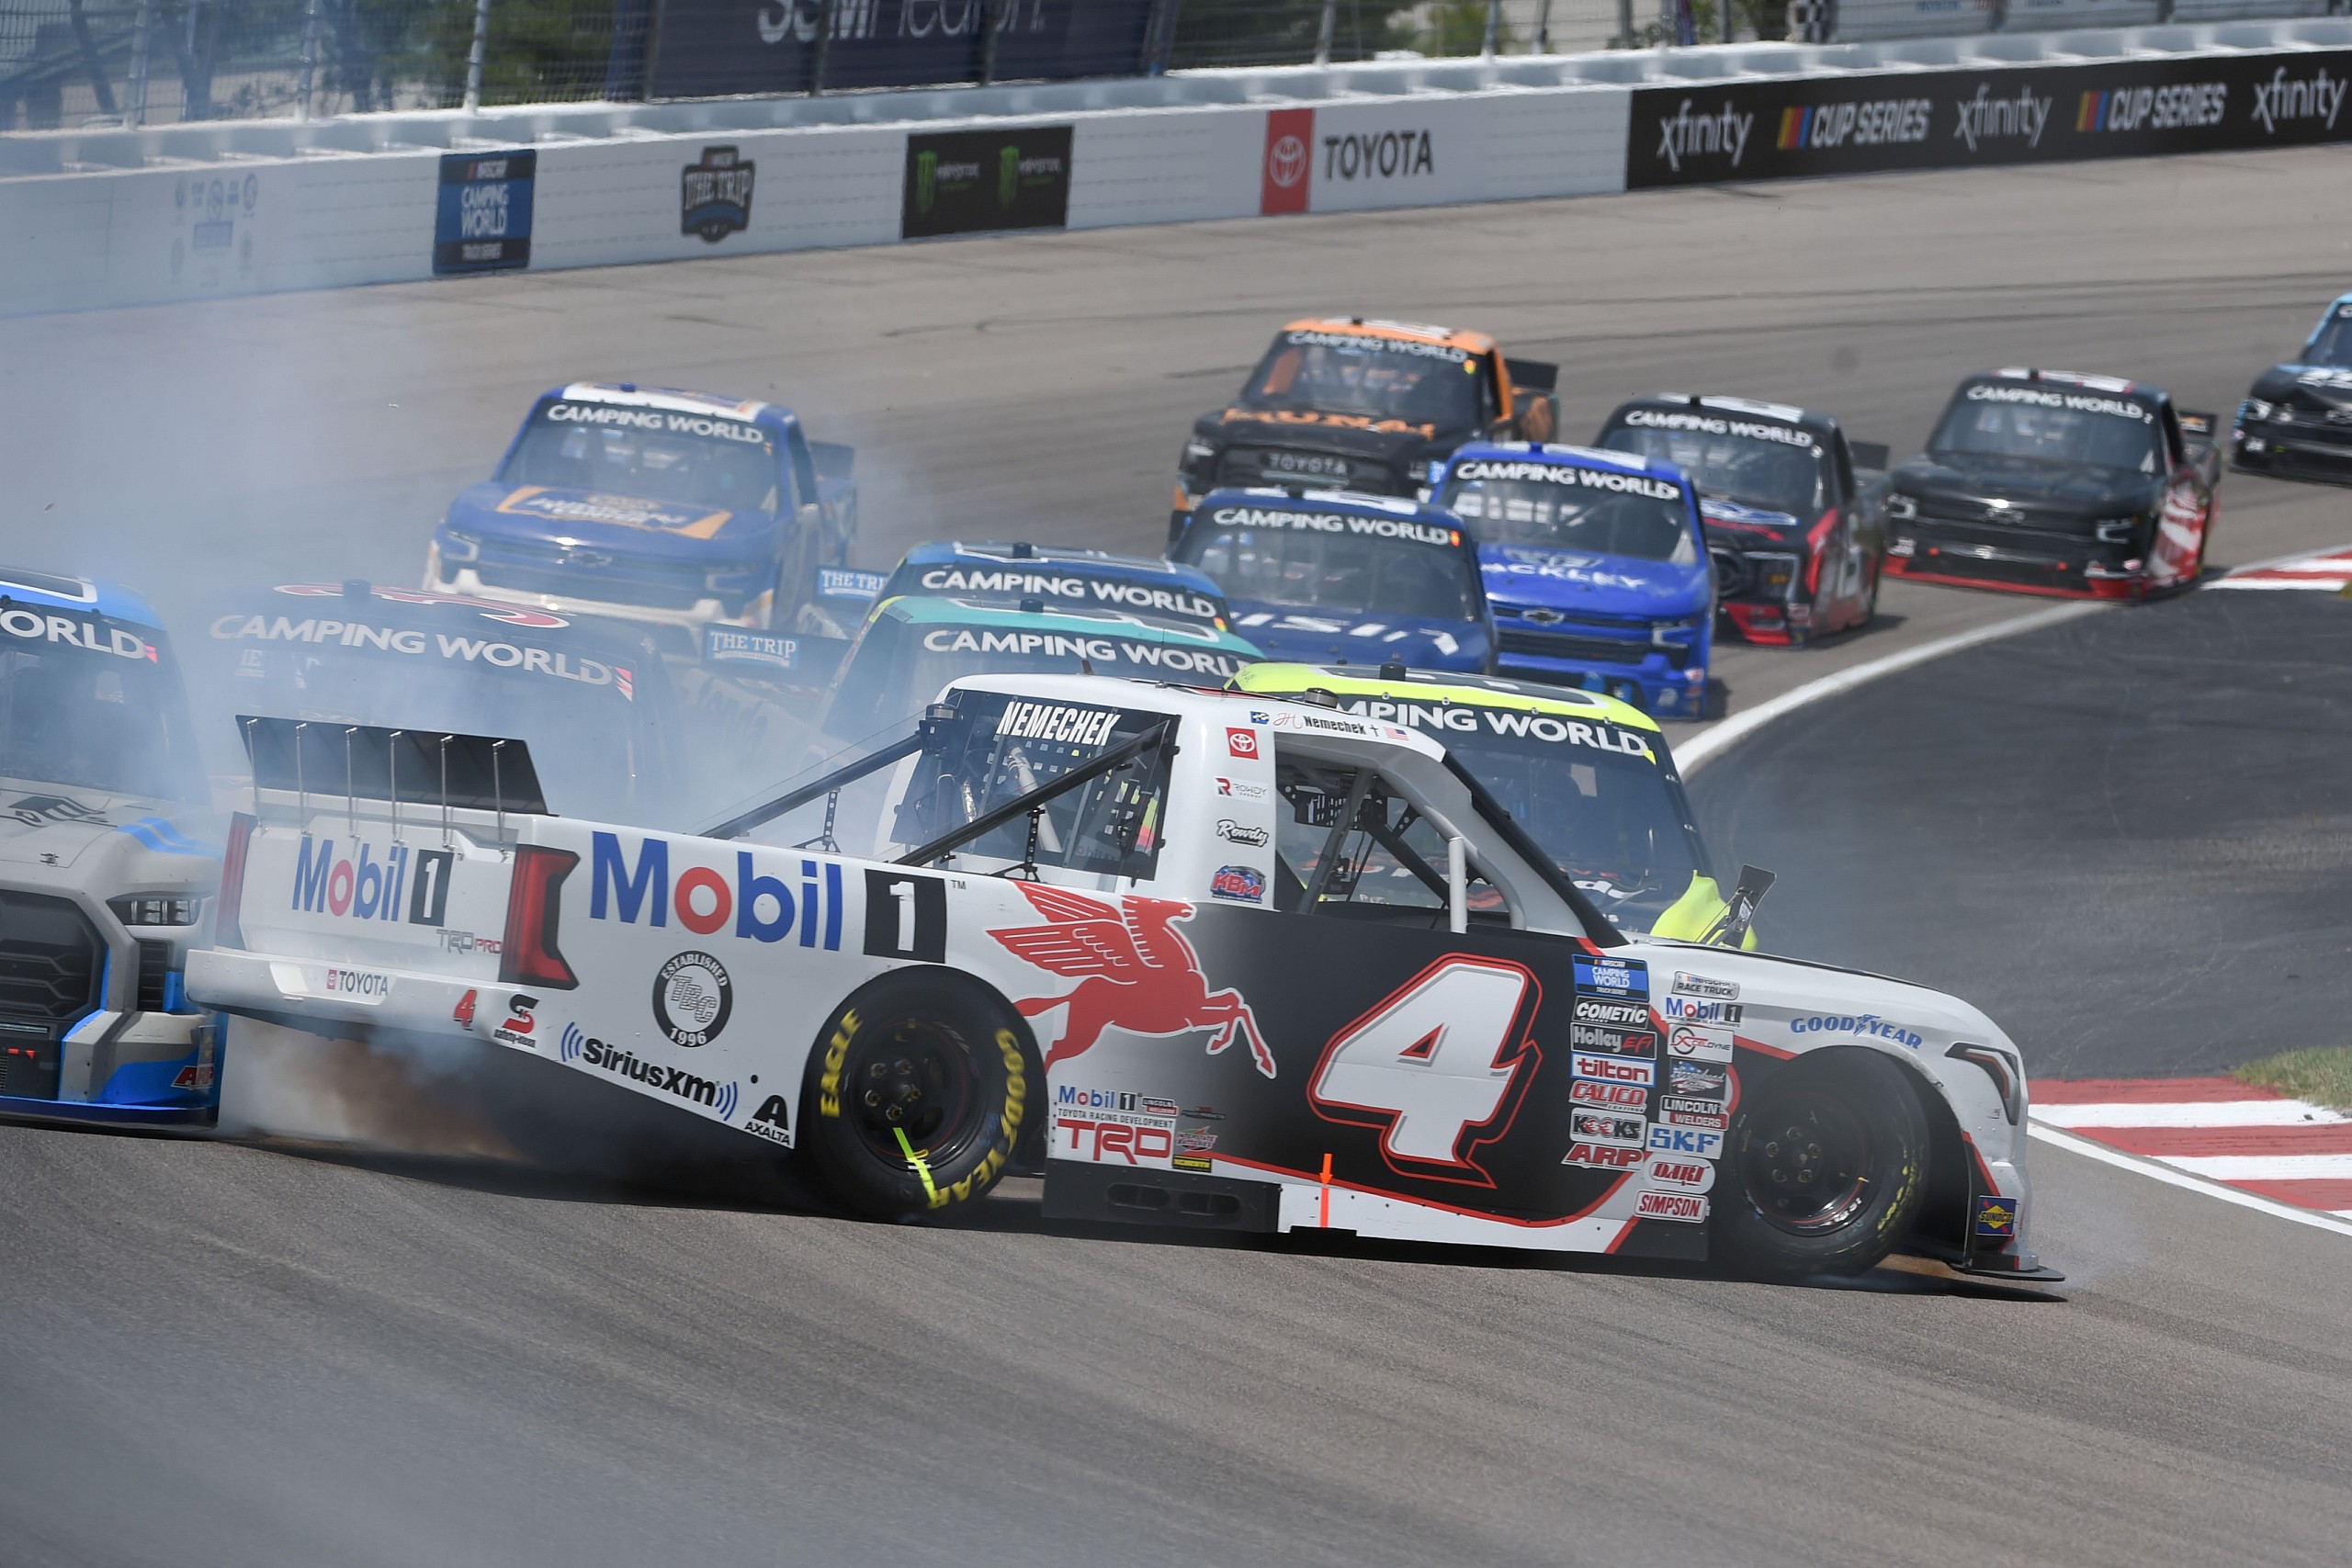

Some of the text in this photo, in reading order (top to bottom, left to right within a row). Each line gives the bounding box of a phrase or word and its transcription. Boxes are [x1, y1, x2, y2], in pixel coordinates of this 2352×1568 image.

[2108, 83, 2227, 130] CUP SERIES
[2251, 66, 2348, 134] xfinity
[1811, 99, 1931, 148] CUP SERIES
[1954, 83, 2052, 152] xfinity
[1657, 98, 1753, 172] xfinity
[1324, 130, 1435, 180] TOYOTA
[461, 184, 509, 209] CAMPING
[461, 208, 508, 237] WORLD
[1287, 331, 1468, 364] CAMPING WORLD
[1966, 385, 2143, 419] CAMPING WORLD
[547, 404, 763, 444] CAMPING WORLD
[1624, 411, 1813, 448] CAMPING WORLD
[1268, 452, 1348, 475] TOYOTA
[1455, 462, 1578, 487] CAMPING
[1579, 468, 1675, 500] WORLD
[1213, 507, 1450, 546] CAMPING WORLD
[820, 570, 883, 591] THE TRI
[922, 570, 1216, 619] CAMPING WORLD
[0, 608, 146, 660] ORLD
[710, 631, 748, 650] THE
[752, 637, 797, 659] TRIP
[923, 629, 1117, 661] CAMPING
[209, 615, 612, 685] CAMPING WORLD
[996, 701, 1122, 746] NEMECHEK
[1303, 716, 1367, 736] Nemechek
[1336, 700, 1650, 757] MPING WORLD
[1217, 818, 1269, 847] Rowdy
[291, 836, 408, 922] Mobil
[590, 830, 842, 952] Mobil
[1212, 872, 1261, 897] KBM
[436, 929, 503, 954] TRD PRO
[339, 970, 388, 997] TOYOTA
[661, 953, 728, 987] ESTABLISHED
[1592, 966, 1630, 978] CAMPING
[1593, 975, 1631, 987] WORLD
[670, 975, 717, 1023] TBC
[1677, 982, 1734, 996] RACE TRUCK
[453, 987, 477, 1031] 4
[1576, 1002, 1648, 1024] COMETIC
[1666, 997, 1720, 1021] Mobil
[670, 1027, 707, 1046] 1996
[1574, 1025, 1622, 1054] Holley
[1791, 1013, 1923, 1049] GOODYEAR
[820, 1008, 864, 1117] EAGLE
[1306, 952, 1544, 1189] 4
[1577, 1057, 1649, 1082] tilton
[1058, 1085, 1115, 1110] Mobil
[1573, 1082, 1645, 1106] CALICO
[1664, 1098, 1720, 1114] LINCOLN
[1058, 1108, 1174, 1129] TOYOTA RACING DEVELOPMENT
[1574, 1114, 1643, 1140] KOOKS
[1675, 1113, 1722, 1128] WELDERS
[744, 1121, 791, 1146] AXALTA
[1057, 1118, 1171, 1165] TRD
[1650, 1127, 1720, 1153] SKF
[1567, 1145, 1643, 1167] ARP
[1639, 1194, 1702, 1217] SIMPSON
